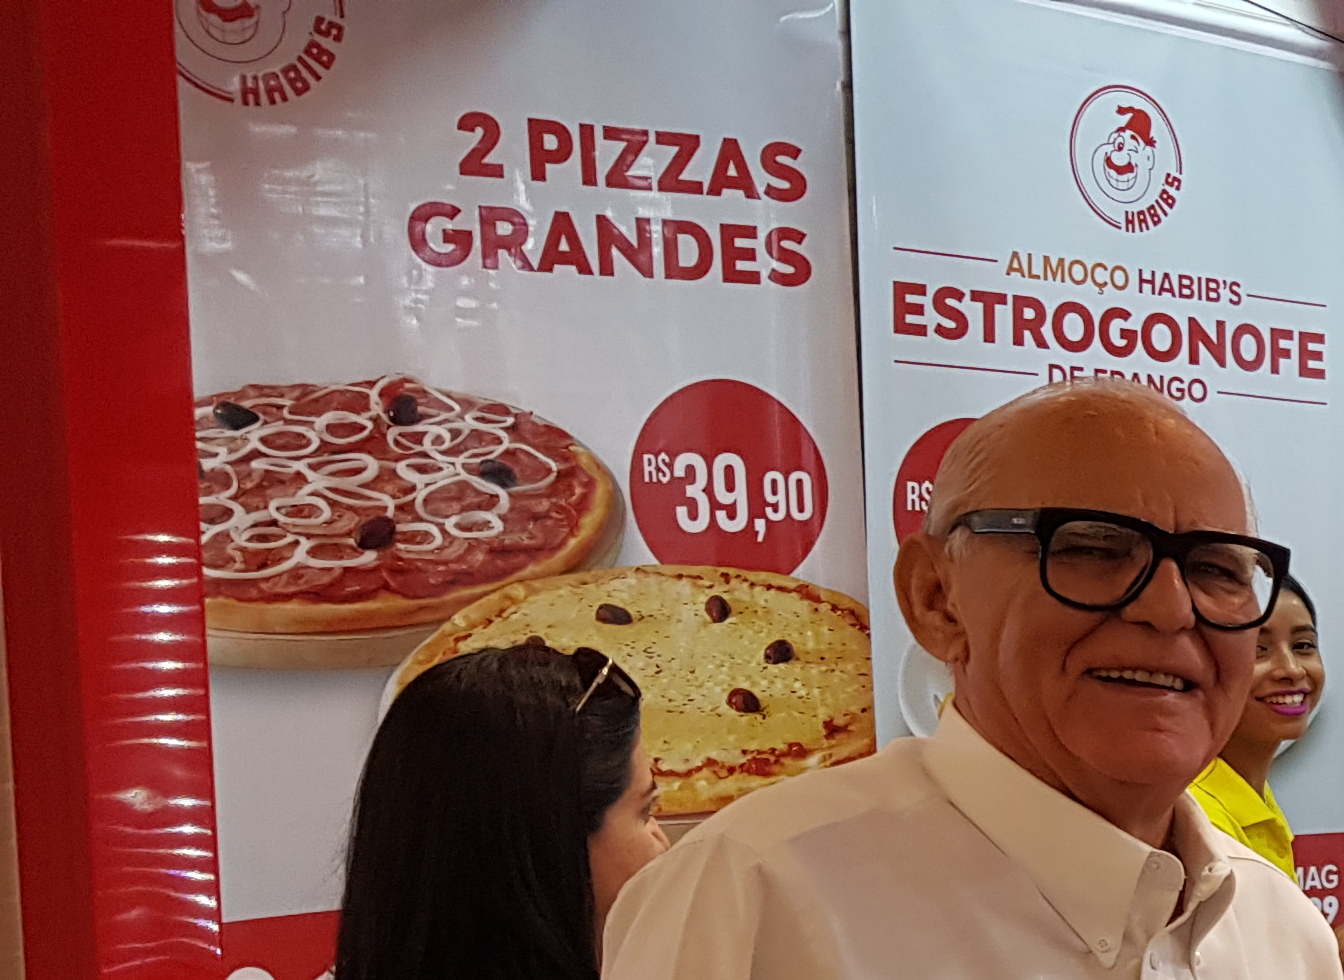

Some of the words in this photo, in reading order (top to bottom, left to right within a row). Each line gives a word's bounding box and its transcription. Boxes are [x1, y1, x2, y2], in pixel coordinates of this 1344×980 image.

[239, 15, 346, 107] HABIB'S
[456, 110, 505, 180] 2
[527, 117, 808, 203] PIZZAS
[408, 201, 812, 287] GRANDES
[1124, 171, 1184, 234] HABIB'S
[1005, 250, 1130, 295] ALMOÇO
[1137, 268, 1243, 307] HABIB'S
[892, 280, 1328, 382] ESTROGONOFE
